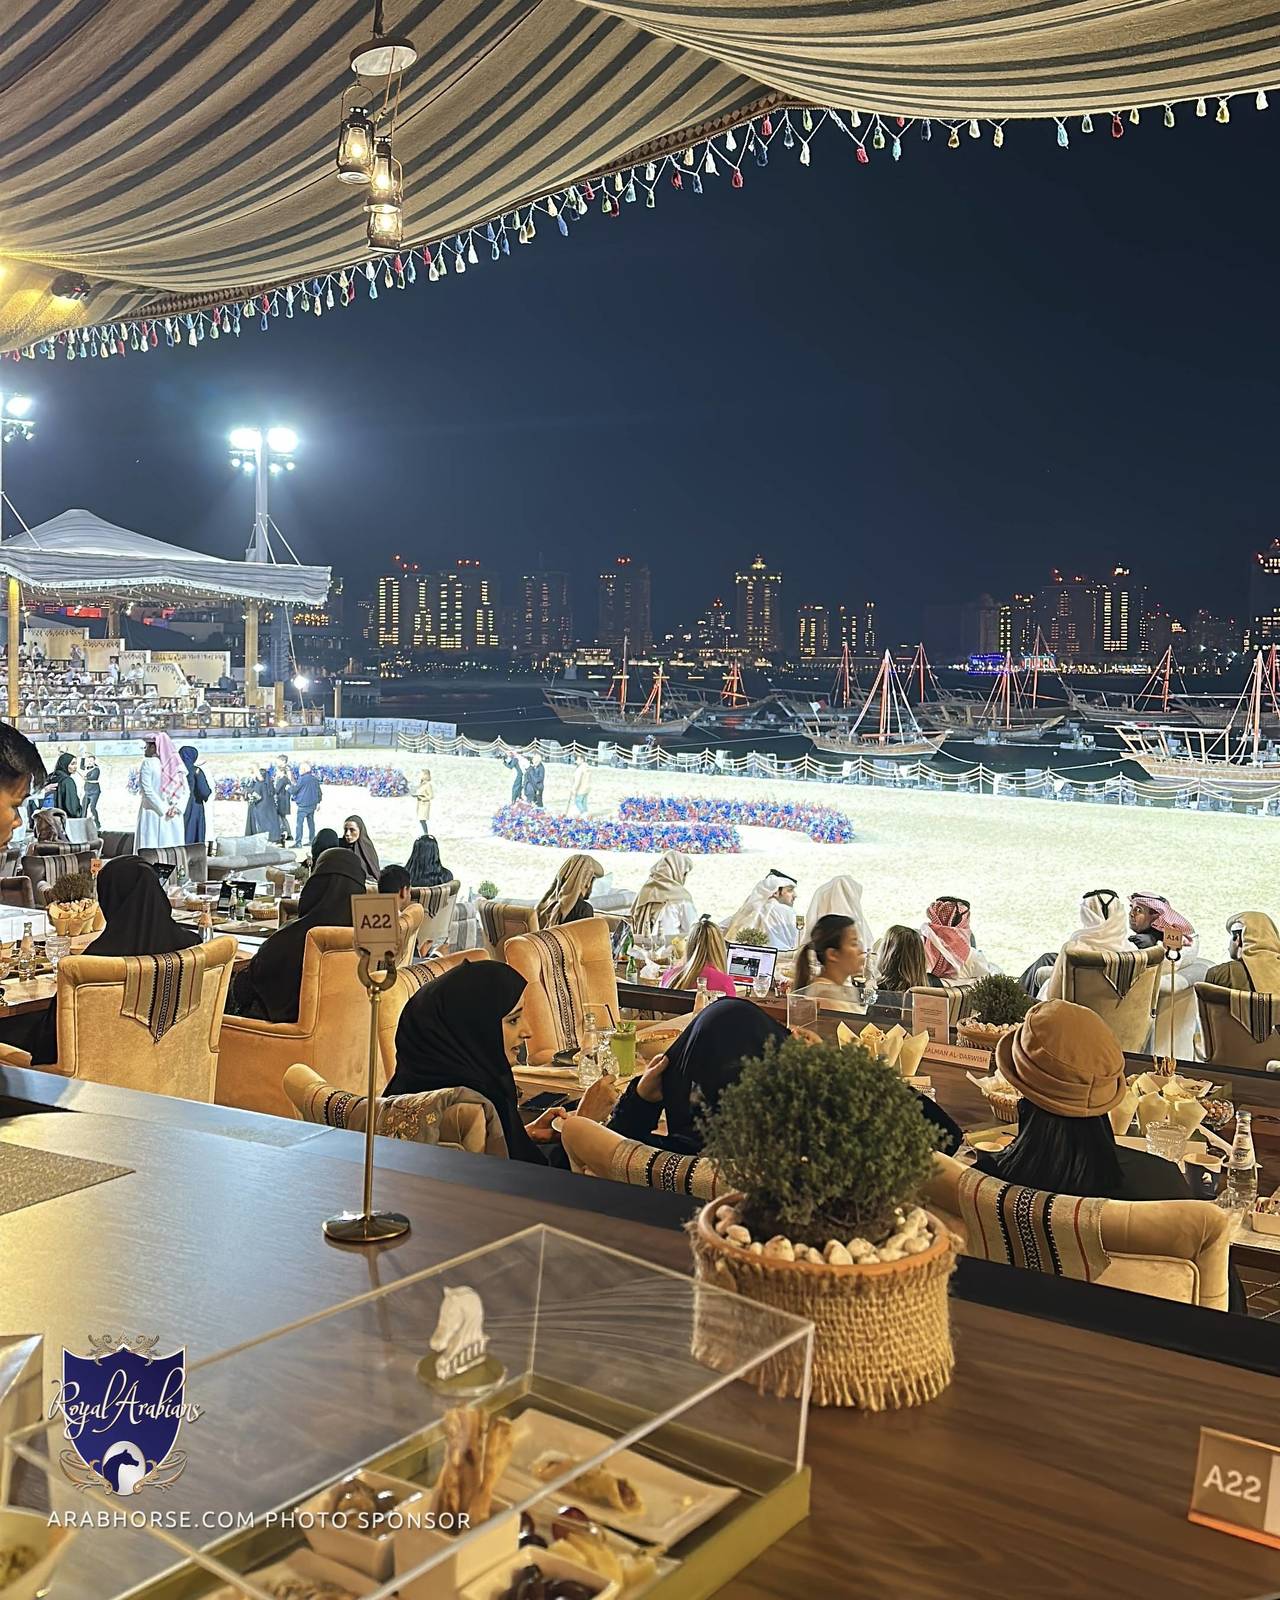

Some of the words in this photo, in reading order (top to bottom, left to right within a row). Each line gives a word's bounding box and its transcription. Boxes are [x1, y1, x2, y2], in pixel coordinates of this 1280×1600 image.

[361, 914, 392, 929] A22
[1166, 934, 1179, 942] A14
[949, 1051, 988, 1064] AL-DARWISH
[1202, 1464, 1262, 1503] A22
